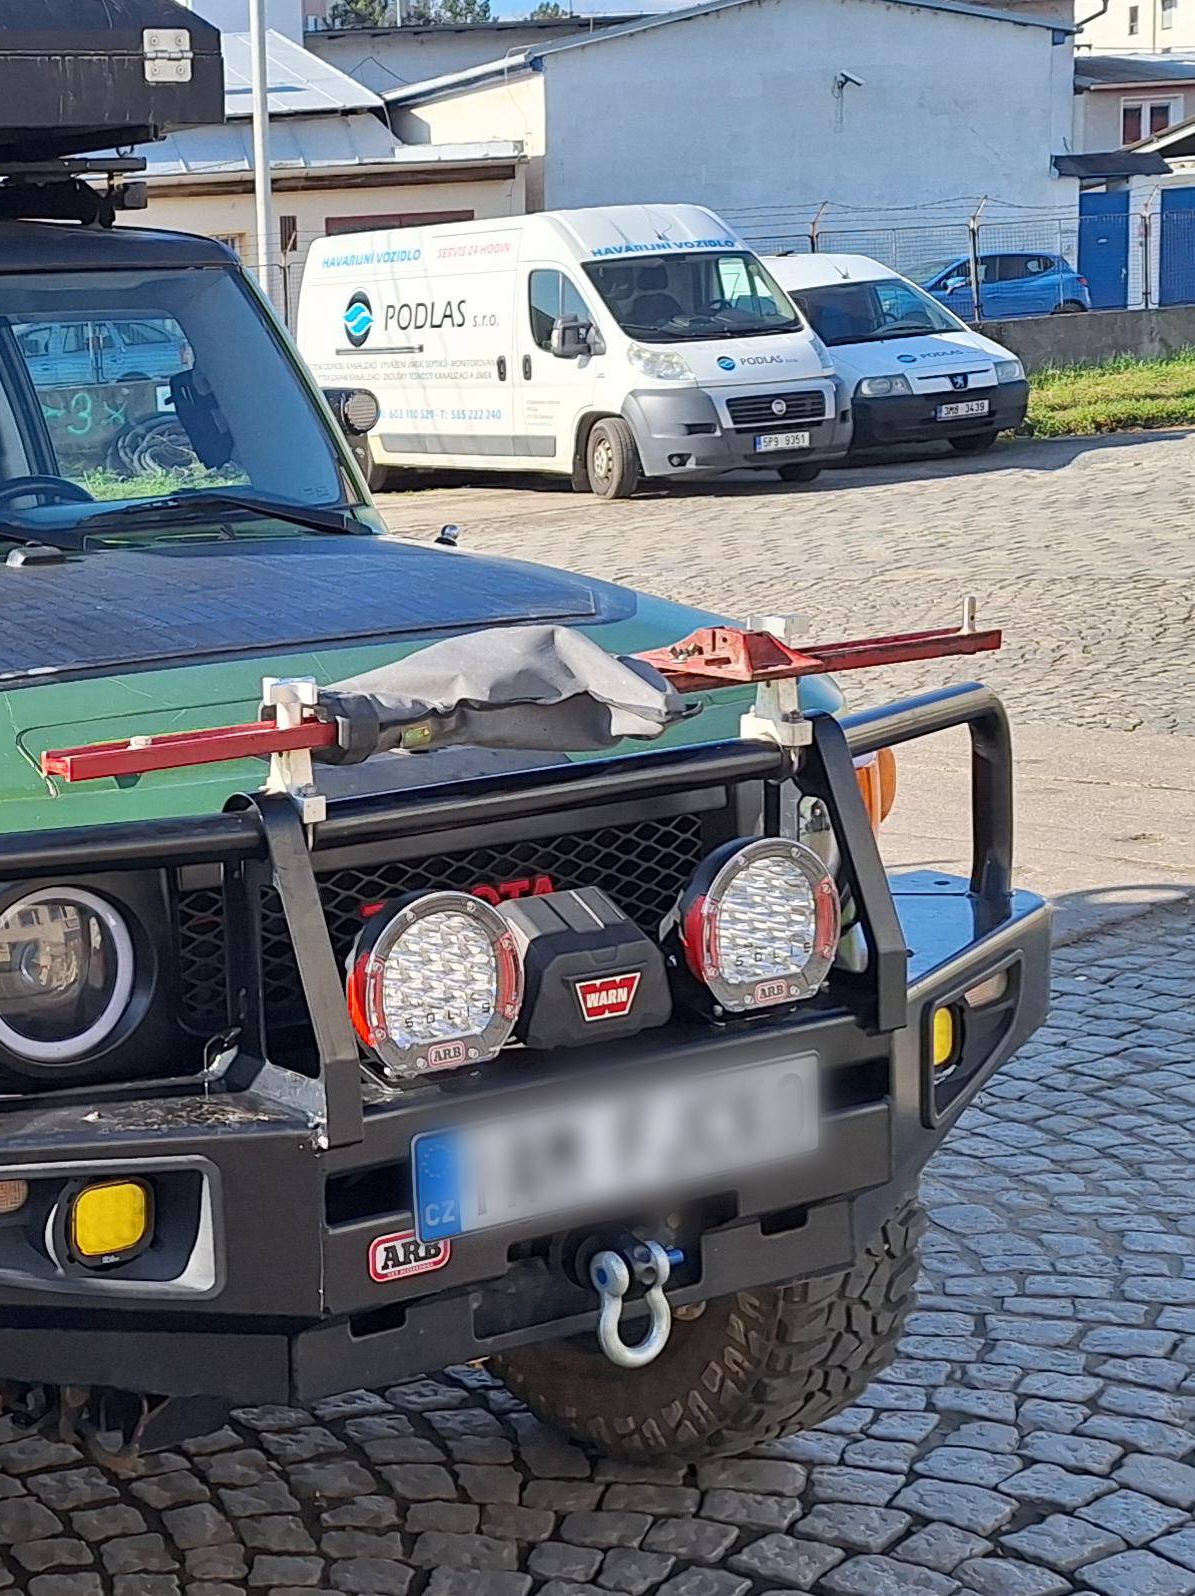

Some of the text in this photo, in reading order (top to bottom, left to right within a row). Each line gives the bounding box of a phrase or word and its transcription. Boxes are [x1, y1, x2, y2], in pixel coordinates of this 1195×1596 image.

[673, 239, 735, 250] VOZIDLO
[376, 249, 421, 263] VOZIDLO
[384, 299, 466, 331] PODLAS
[740, 355, 784, 366] PODLAS
[763, 434, 805, 448] 5P9 9351
[586, 987, 628, 1008] WARN
[759, 984, 784, 999] ARB
[405, 1003, 490, 1028] SOLIS
[433, 1046, 462, 1062] ARB
[425, 1200, 457, 1227] CZ
[381, 1240, 442, 1271] ARB
